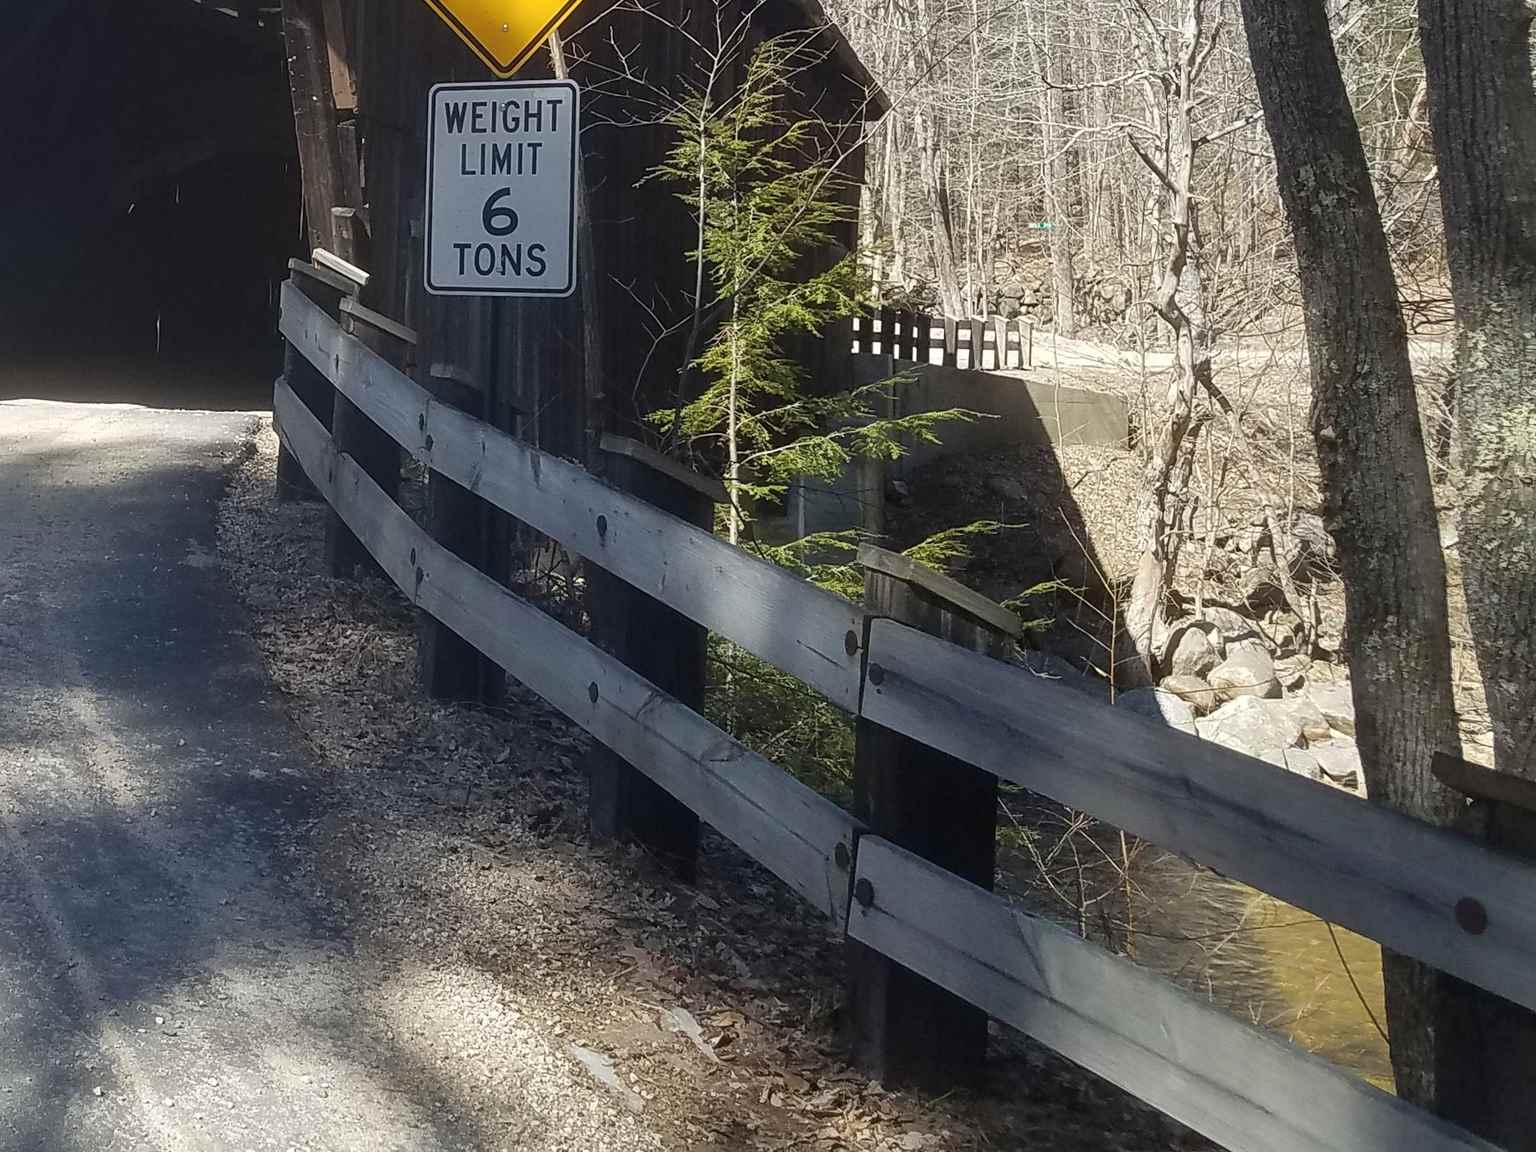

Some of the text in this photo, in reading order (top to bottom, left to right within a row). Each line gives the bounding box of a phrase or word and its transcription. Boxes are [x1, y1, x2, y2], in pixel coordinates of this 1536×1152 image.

[444, 99, 563, 134] WEIGHT
[460, 143, 543, 175] LIMIT
[482, 187, 519, 236] 6
[453, 242, 546, 276] TONS
